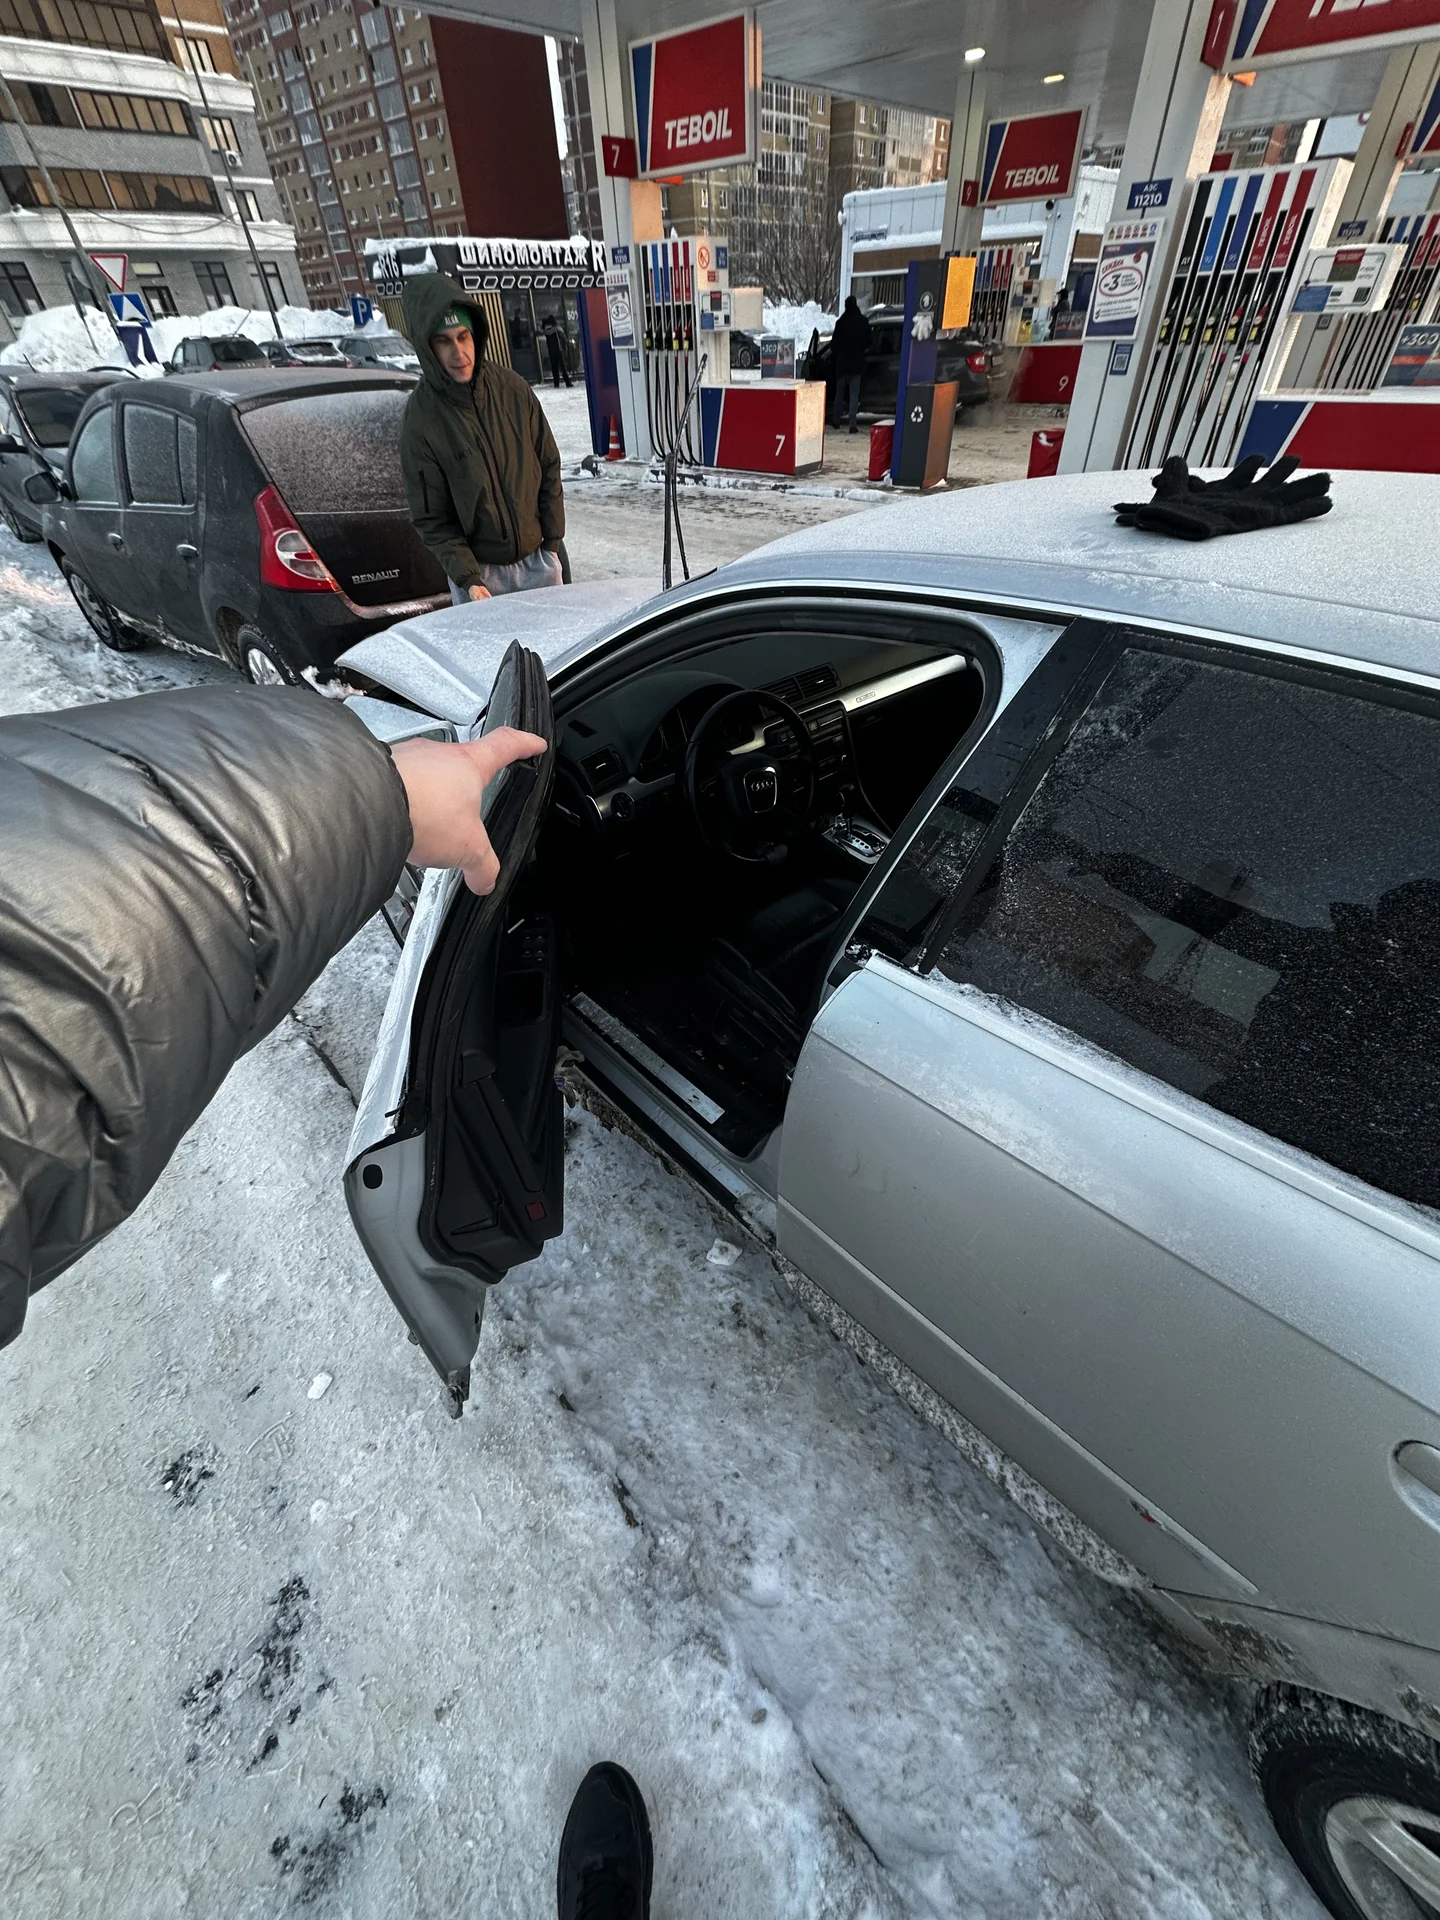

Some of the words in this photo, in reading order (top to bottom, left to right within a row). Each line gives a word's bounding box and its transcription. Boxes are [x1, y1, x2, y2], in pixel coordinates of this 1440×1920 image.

[665, 108, 732, 150] TEBOIL
[611, 144, 620, 169] 7
[1004, 164, 1060, 189] TEBOIL
[966, 185, 972, 201] 9
[1134, 192, 1162, 208] 11210
[378, 251, 400, 279] R16
[458, 244, 588, 266] ШИНОМОНТАЖ
[1103, 273, 1121, 291] -3
[358, 301, 367, 324] P
[1059, 375, 1068, 392] 9
[775, 434, 786, 457] 7
[352, 569, 399, 585] RENAULT
